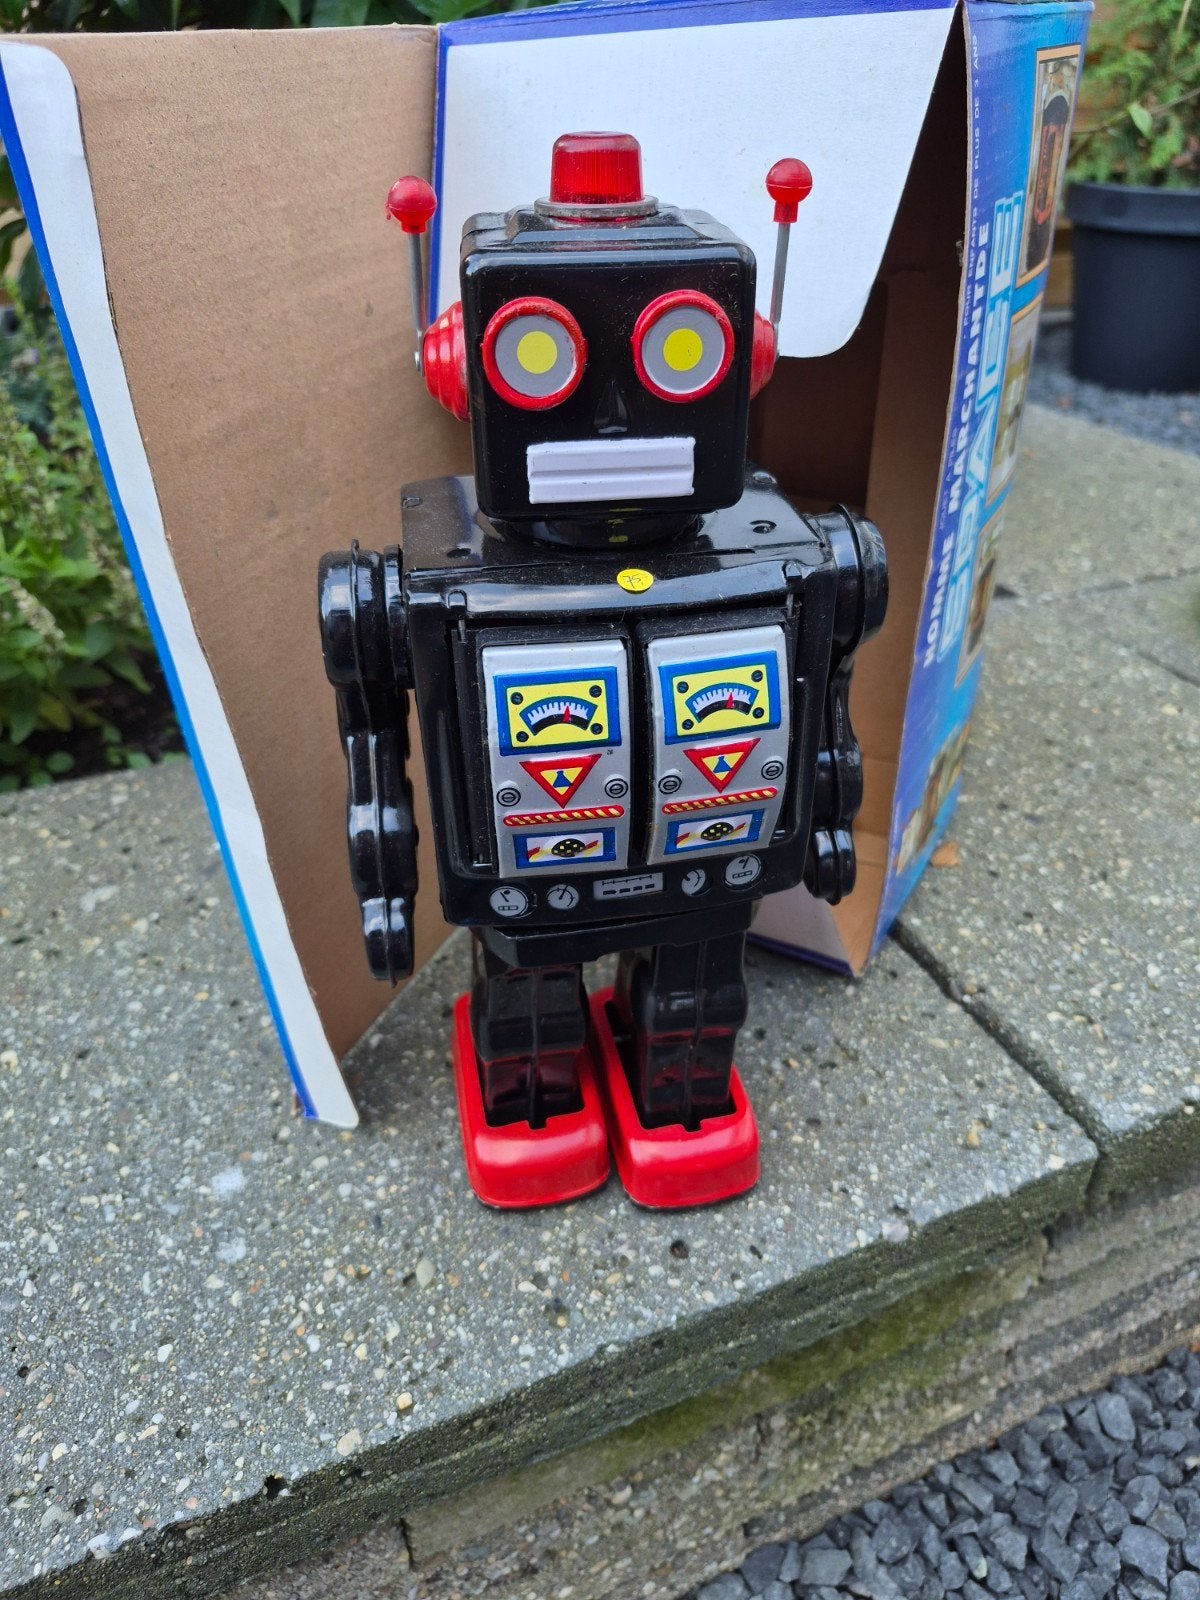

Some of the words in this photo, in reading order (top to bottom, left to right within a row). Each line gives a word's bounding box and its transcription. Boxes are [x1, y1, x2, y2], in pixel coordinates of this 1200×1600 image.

[974, 97, 980, 119] DE
[973, 178, 979, 199] DE
[968, 207, 979, 278] ENFANTS
[963, 284, 972, 327] POUR
[936, 190, 1024, 663] SPACE
[923, 532, 954, 669] HOMME
